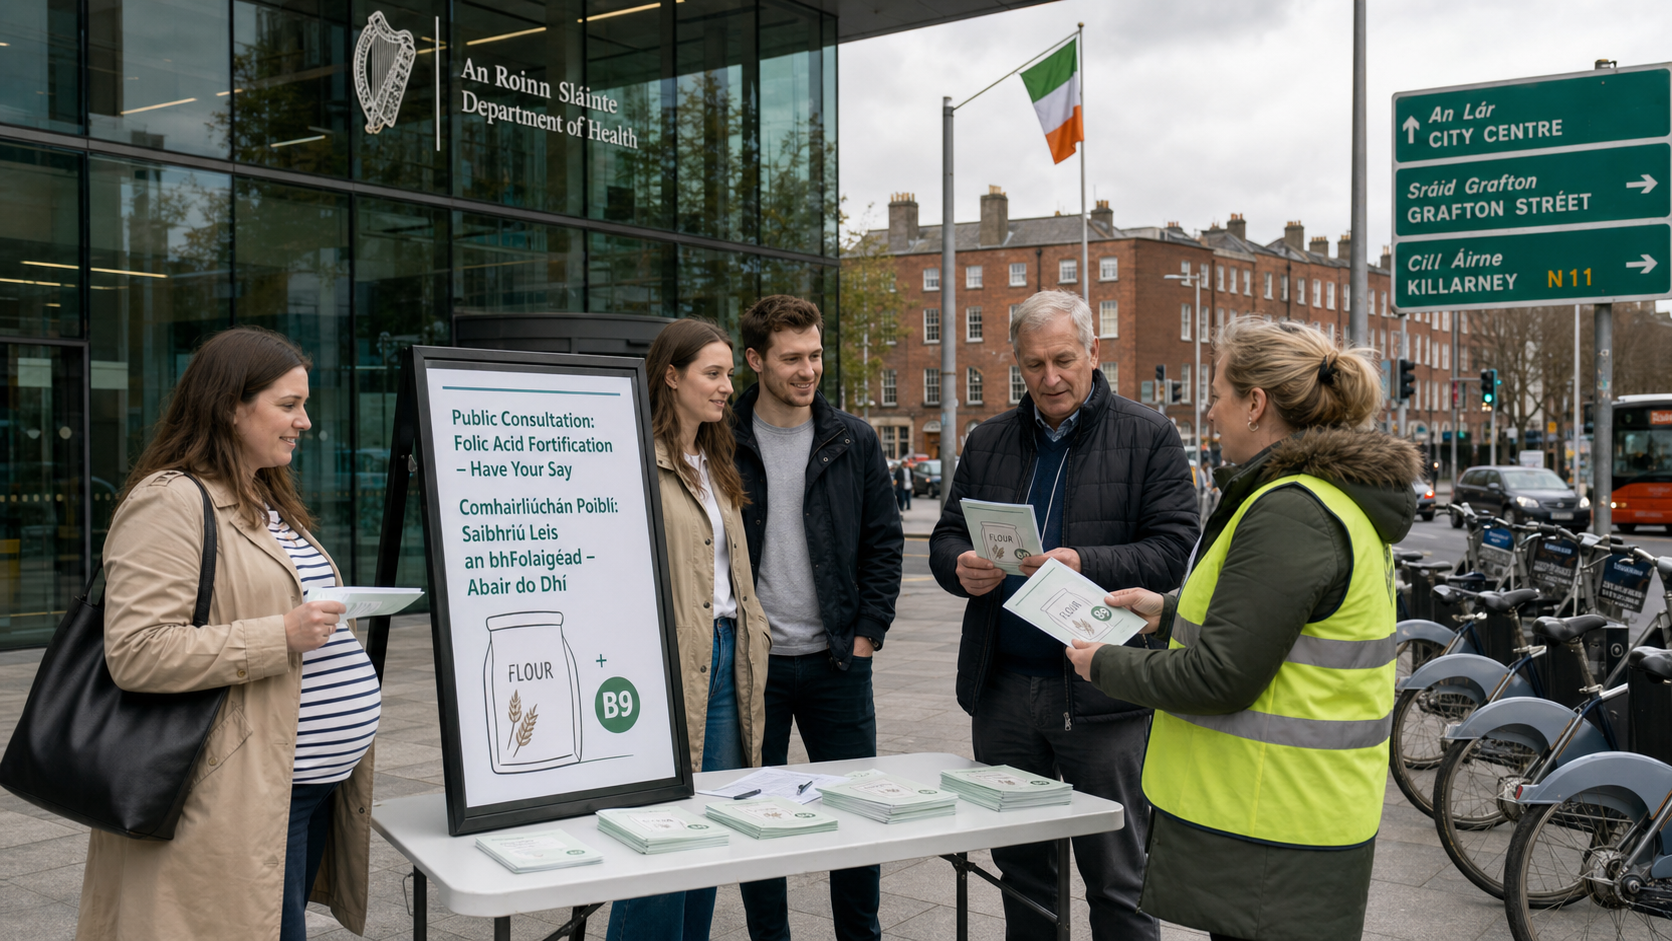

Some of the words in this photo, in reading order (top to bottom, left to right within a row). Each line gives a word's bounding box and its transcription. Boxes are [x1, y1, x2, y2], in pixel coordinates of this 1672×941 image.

[461, 57, 489, 83] An
[495, 65, 551, 99] Roinn
[559, 81, 618, 114] Sláinte
[461, 90, 562, 133] Department
[566, 116, 586, 137] of
[588, 119, 638, 149] Health
[1428, 106, 1453, 124] An
[1463, 101, 1495, 120] Lár
[1429, 128, 1474, 148] CITY
[1484, 119, 1563, 143] CENTRE
[1407, 179, 1456, 199] Sráid
[1465, 174, 1537, 194] Grafton
[1407, 200, 1504, 224] GRAFTON
[1515, 190, 1592, 215] STRÉET
[1408, 253, 1442, 272] Cill
[1451, 248, 1503, 269] Áirne
[1407, 273, 1518, 295] KILLARNEY
[452, 409, 498, 427] Public
[501, 411, 595, 428] Consultation:
[454, 435, 489, 452] Folic
[493, 435, 524, 452] Acid
[528, 436, 613, 453] Fortification
[470, 461, 508, 477] Have
[511, 461, 544, 477] Your
[548, 461, 573, 481] Say
[459, 497, 573, 516] Comhairliúchán
[577, 496, 619, 514] Poiblí:
[462, 524, 526, 543] Saibhriú
[530, 524, 559, 541] Leis
[989, 533, 1013, 543] FLOUR
[465, 555, 484, 570] an
[489, 548, 582, 571] bhFolaigéad
[467, 577, 511, 596] Abair
[516, 576, 536, 593] do
[540, 574, 567, 593] Dhí
[508, 661, 554, 683] FLOUR
[602, 690, 633, 719] B9
